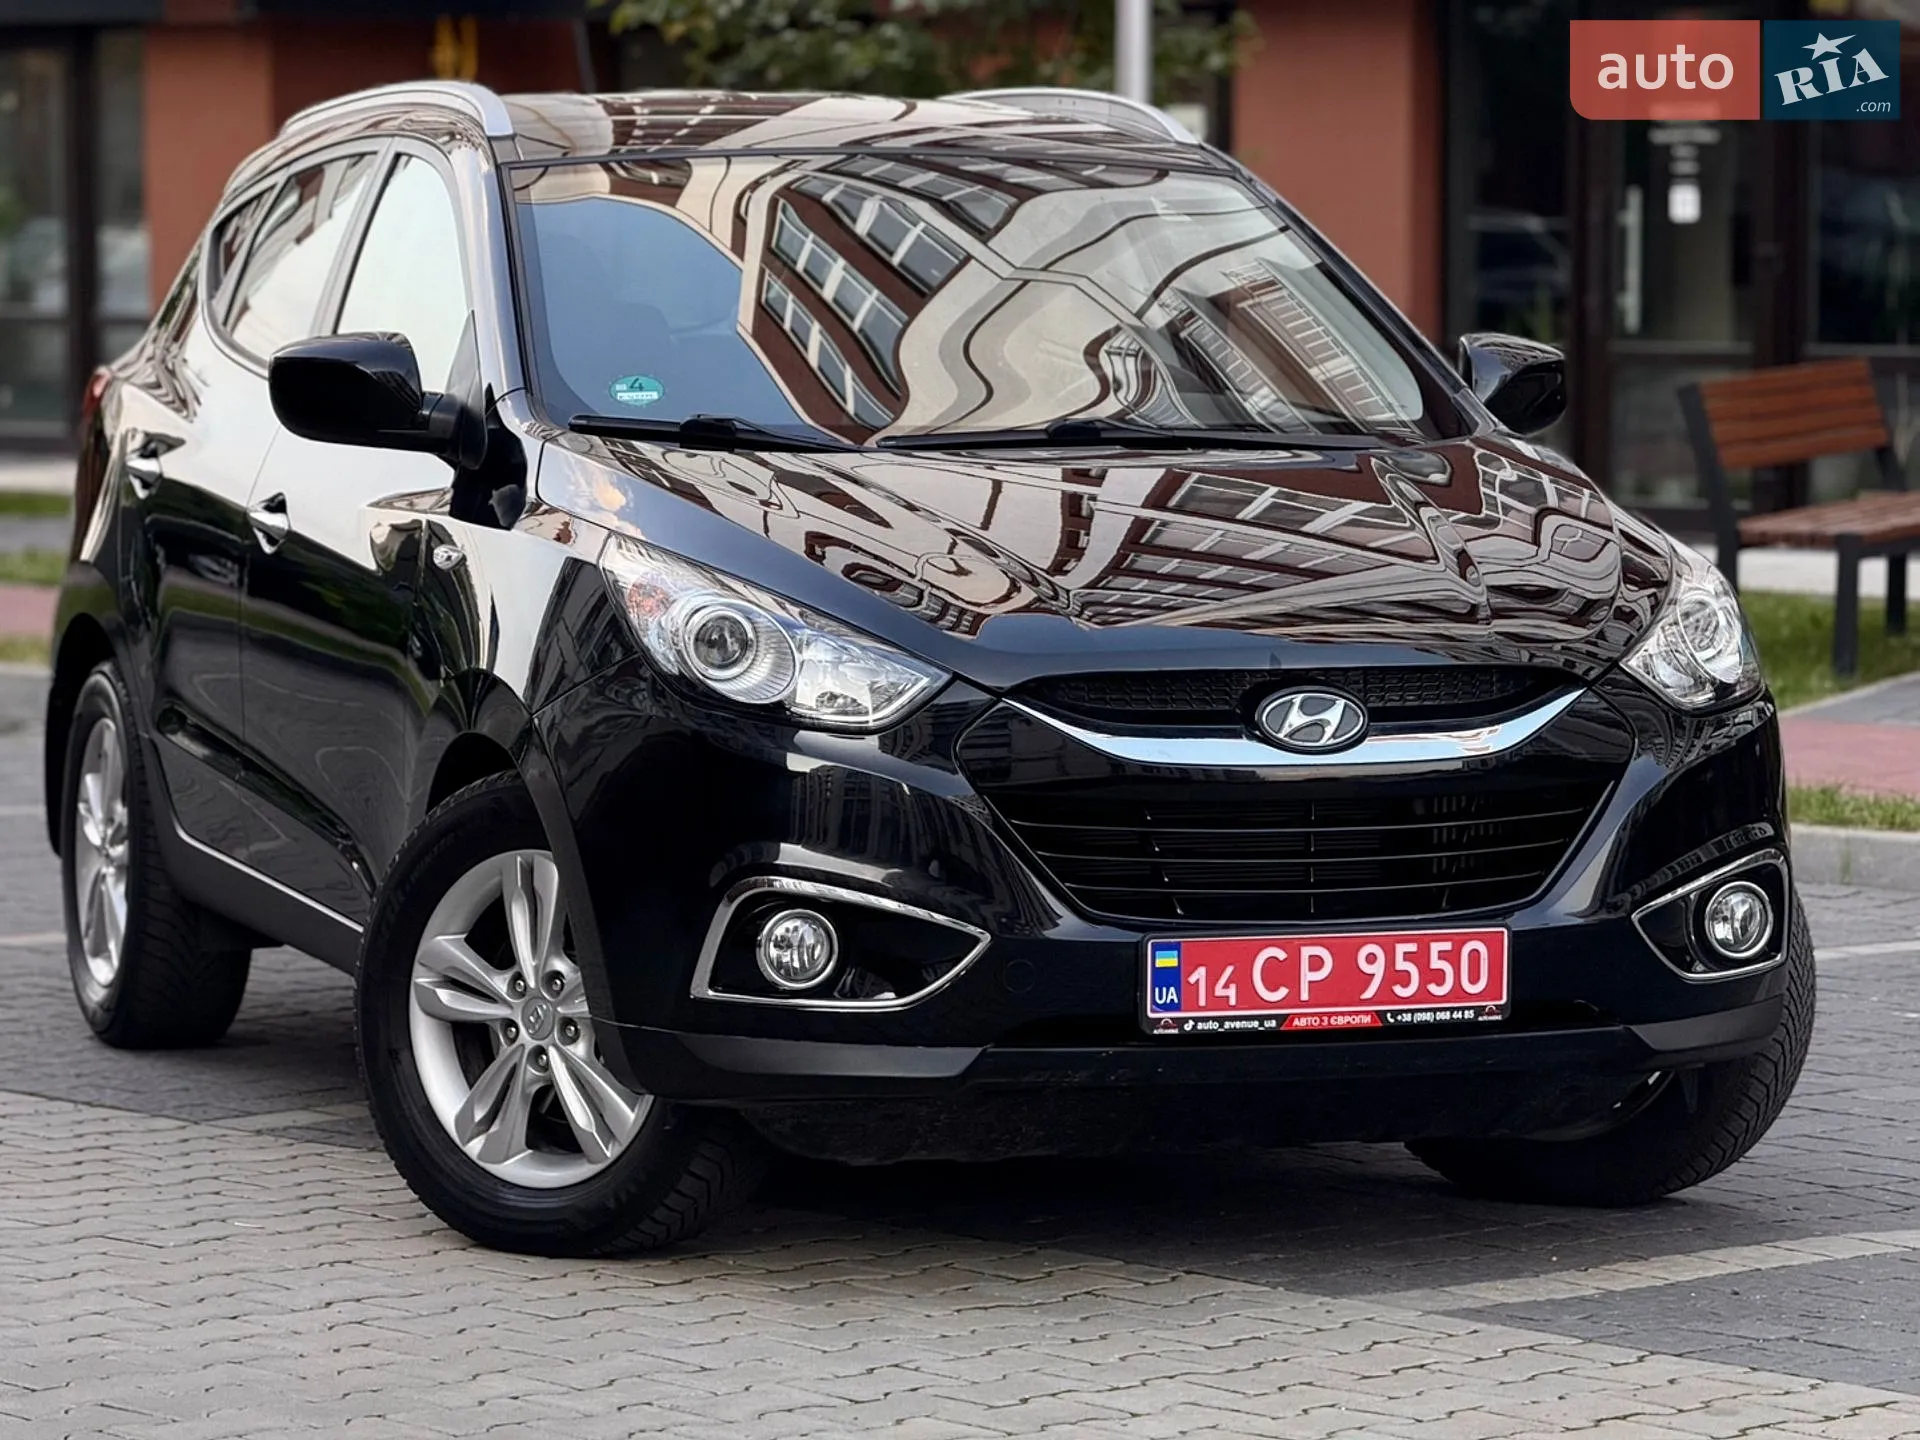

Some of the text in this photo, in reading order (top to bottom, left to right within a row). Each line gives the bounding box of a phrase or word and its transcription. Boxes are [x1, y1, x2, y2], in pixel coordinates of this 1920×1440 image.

[629, 377, 645, 392] 4
[1187, 940, 1489, 1007] 14 CP 9550
[1154, 986, 1179, 1005] UA
[1196, 1018, 1277, 1032] auto_avenue_ua
[1292, 1017, 1320, 1027] АВТО
[1330, 1014, 1372, 1025] ЄВРОПИ
